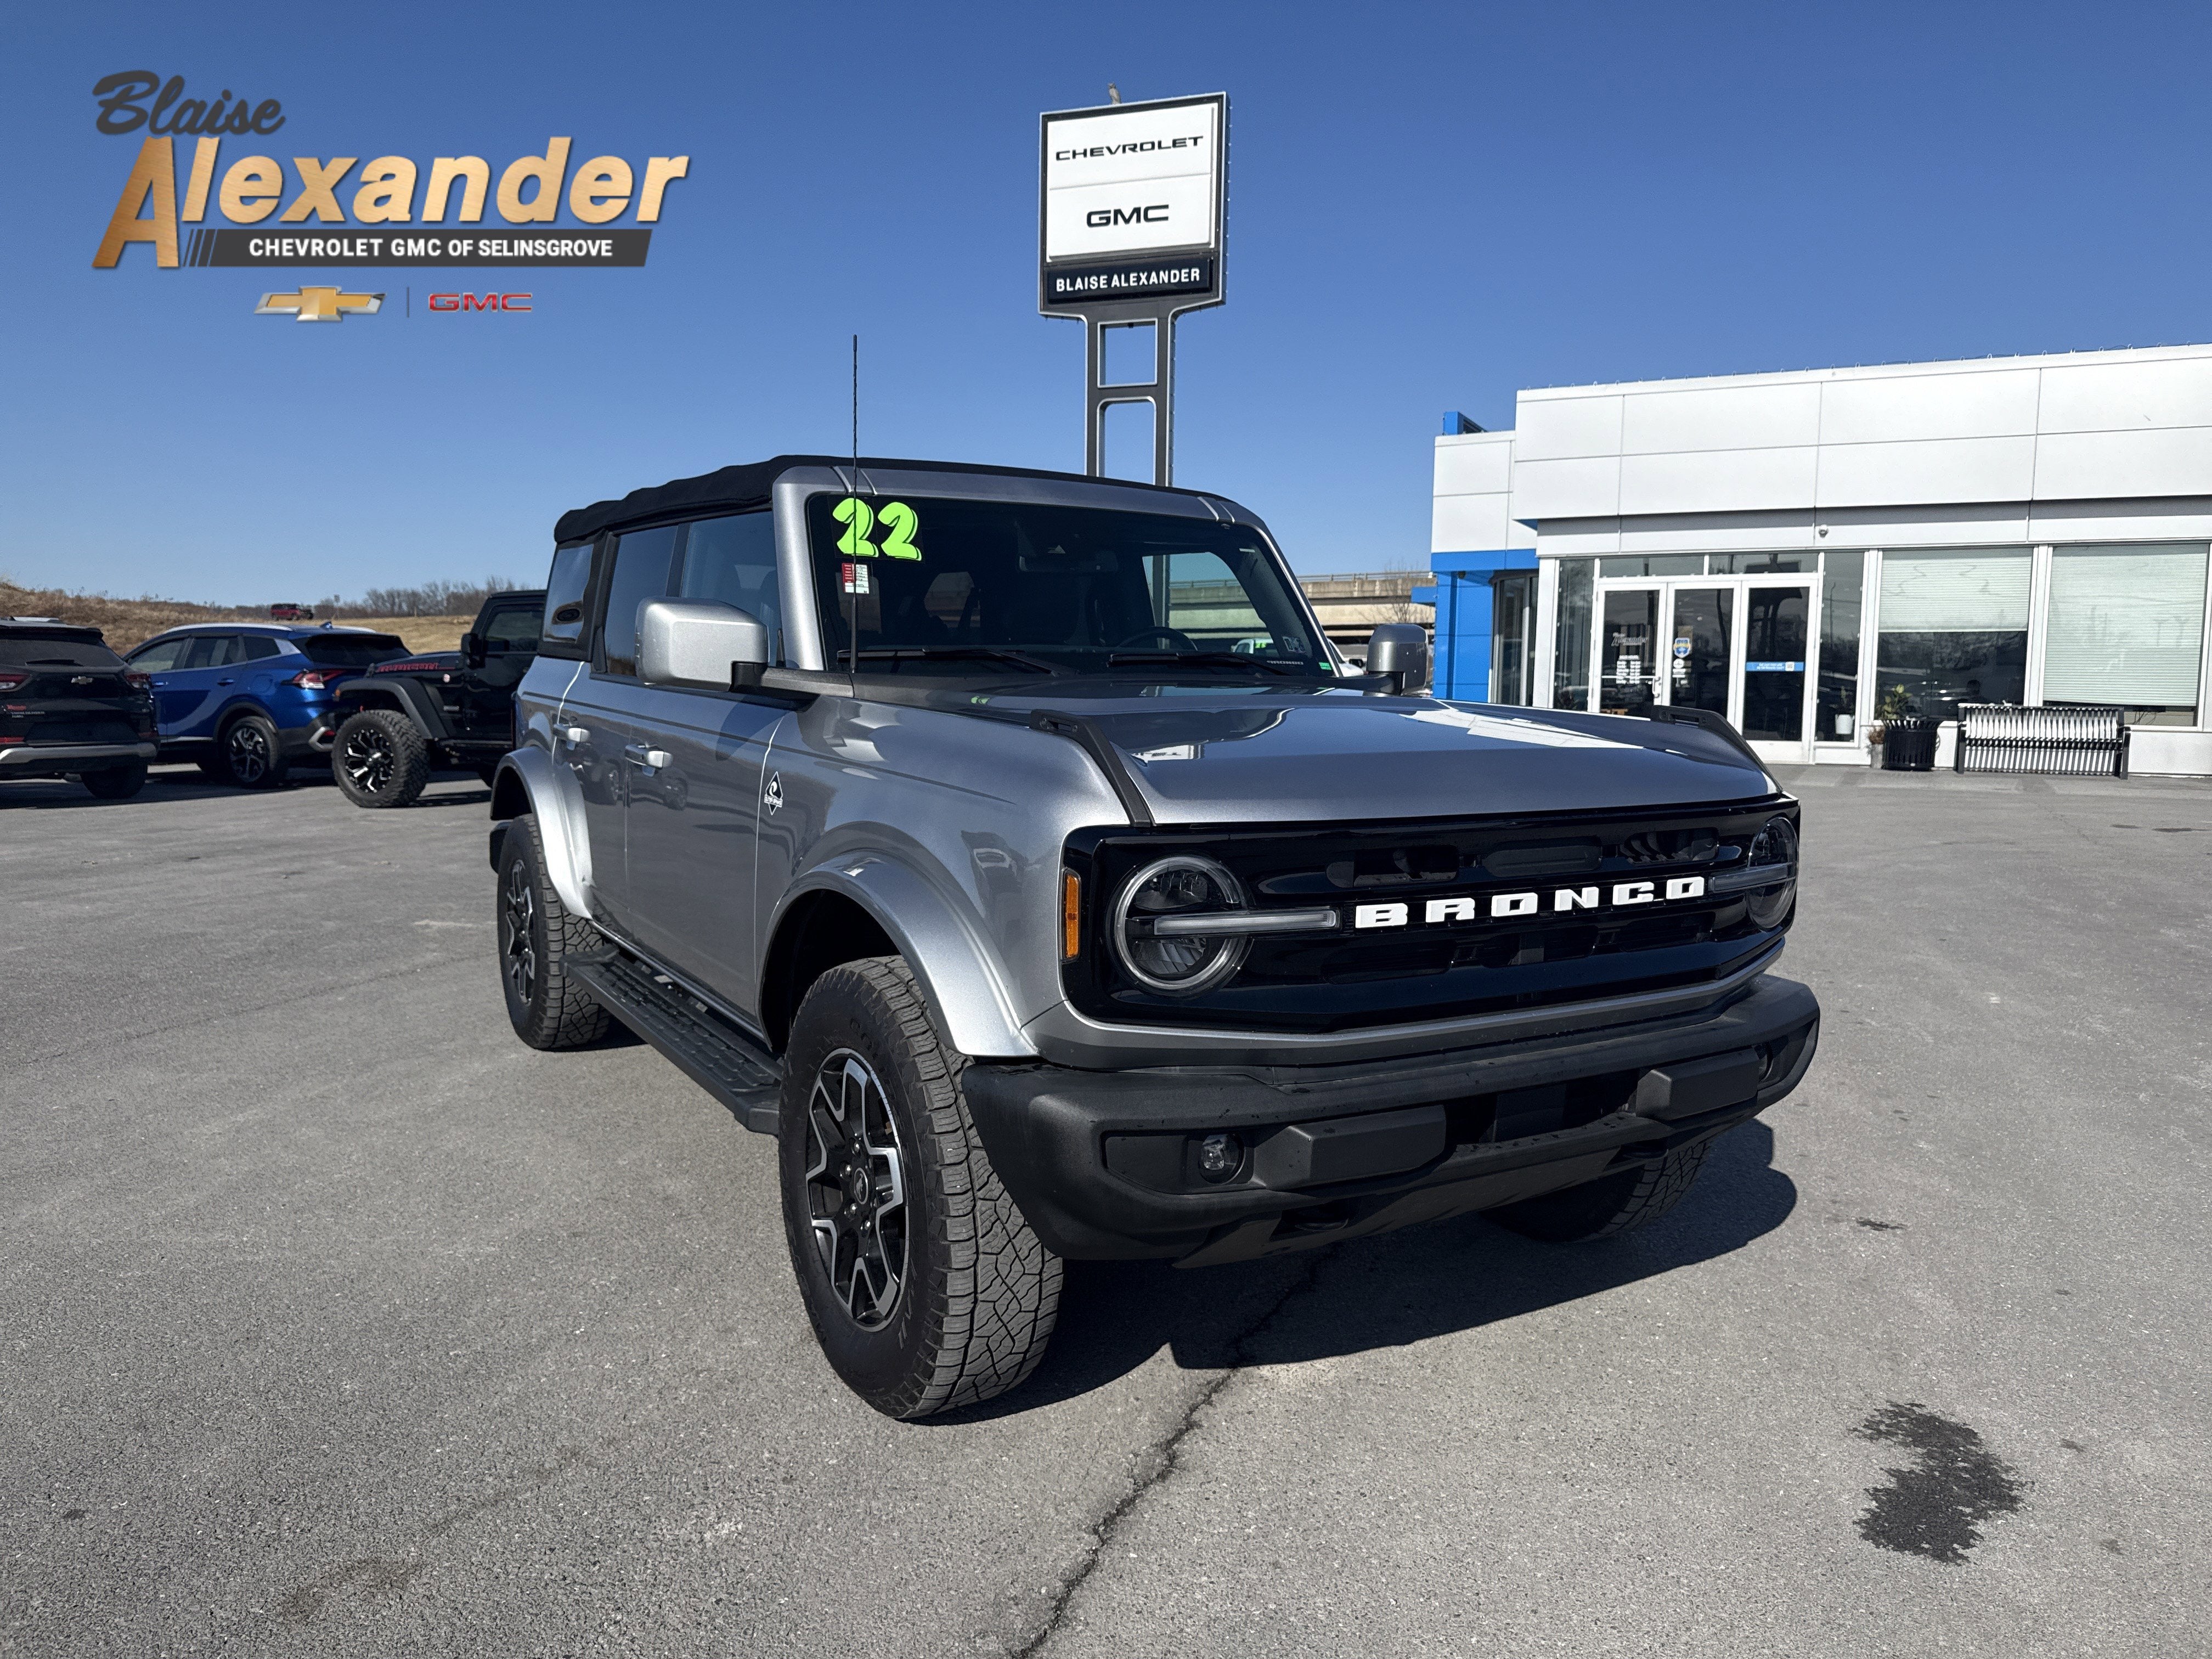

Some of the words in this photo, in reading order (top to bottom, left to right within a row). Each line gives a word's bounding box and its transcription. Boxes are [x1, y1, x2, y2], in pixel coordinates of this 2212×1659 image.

[1056, 136, 1204, 161] CHEVROLET
[1087, 204, 1169, 228] GMC
[1056, 274, 1108, 292] BLAISE
[1110, 267, 1200, 287] ALEXANDER
[832, 498, 922, 561] 22
[1355, 876, 1705, 928] BRONCO
